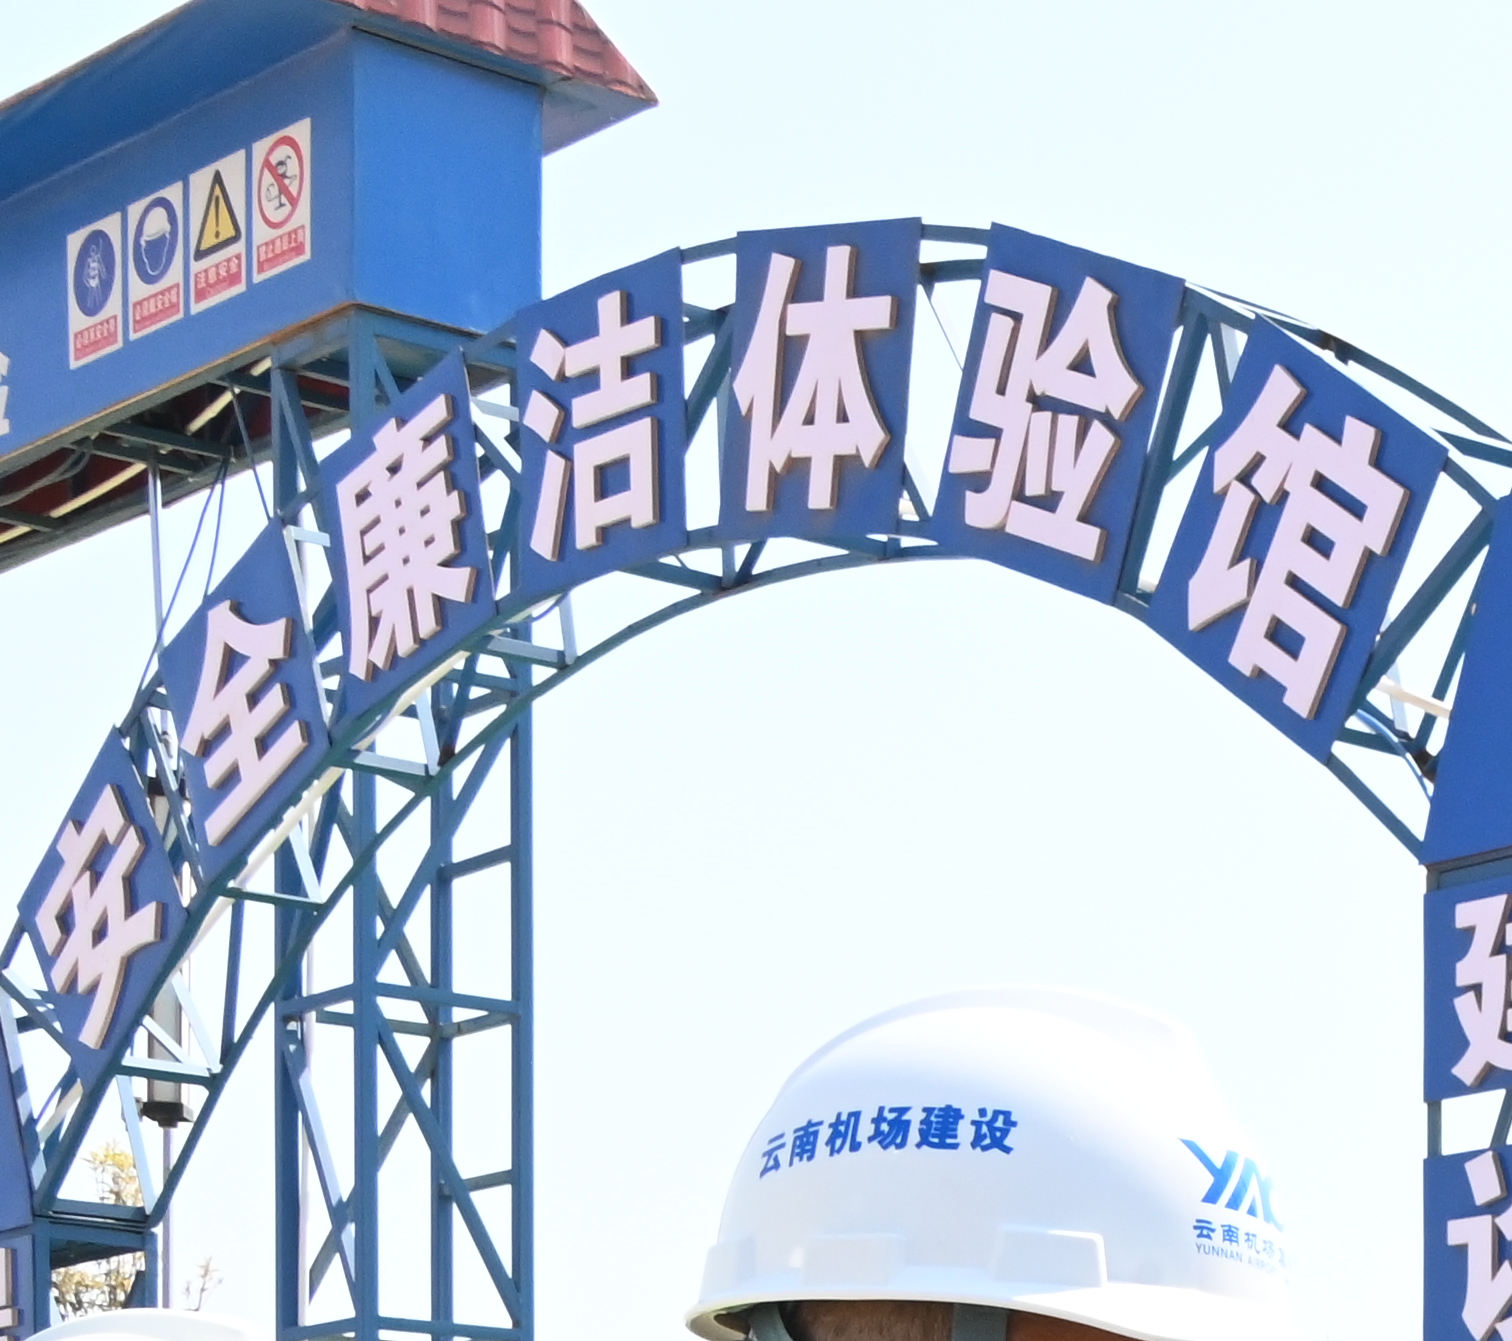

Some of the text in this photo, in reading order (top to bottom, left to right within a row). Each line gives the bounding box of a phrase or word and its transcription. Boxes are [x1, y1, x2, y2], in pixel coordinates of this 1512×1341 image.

[36, 245, 1412, 1050] 安全廉洁体验馆
[758, 1104, 1019, 1180] 云南机场建设
[1195, 1242, 1243, 1263] YUNNAN
